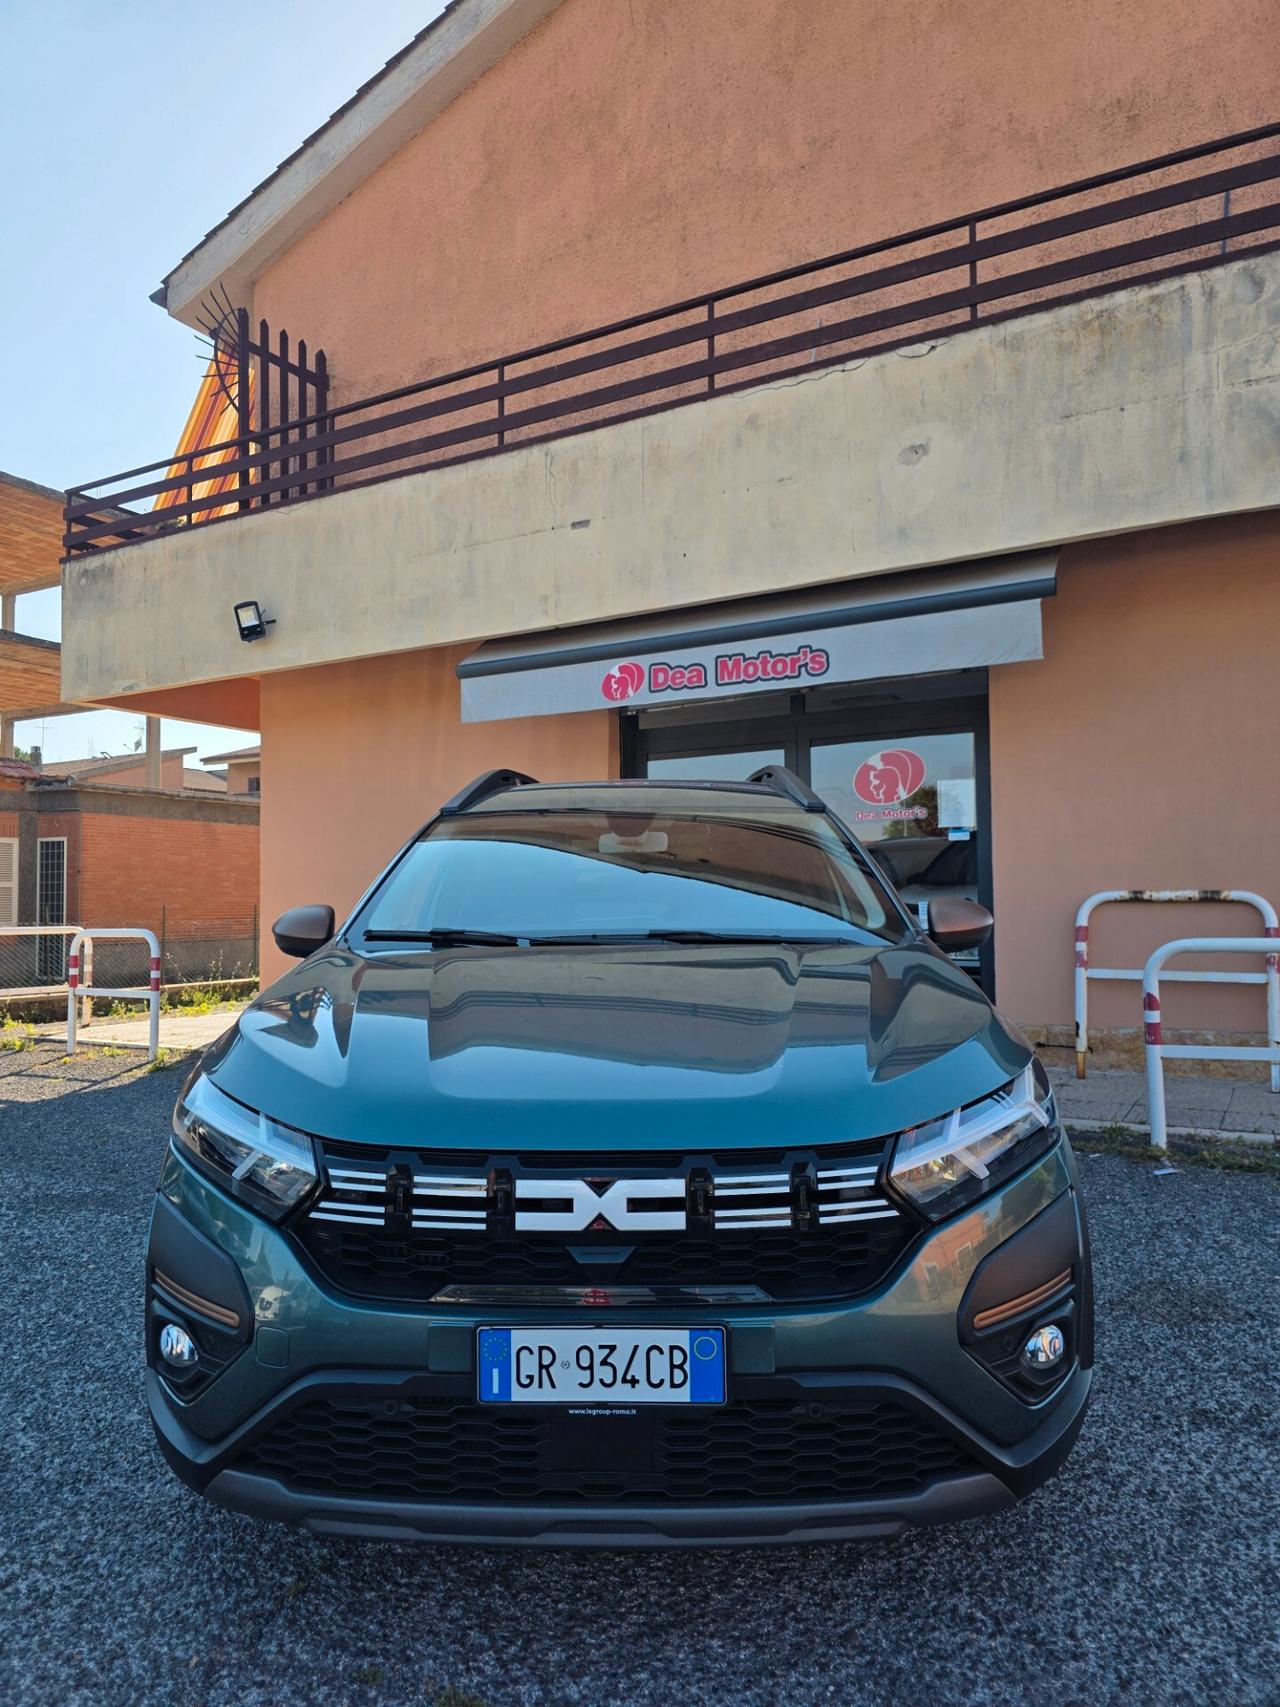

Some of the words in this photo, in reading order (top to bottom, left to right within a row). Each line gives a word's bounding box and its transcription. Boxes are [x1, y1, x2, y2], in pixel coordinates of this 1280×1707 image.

[650, 663, 706, 692] Dea
[716, 646, 828, 685] Motor's
[881, 807, 927, 820] Motor's
